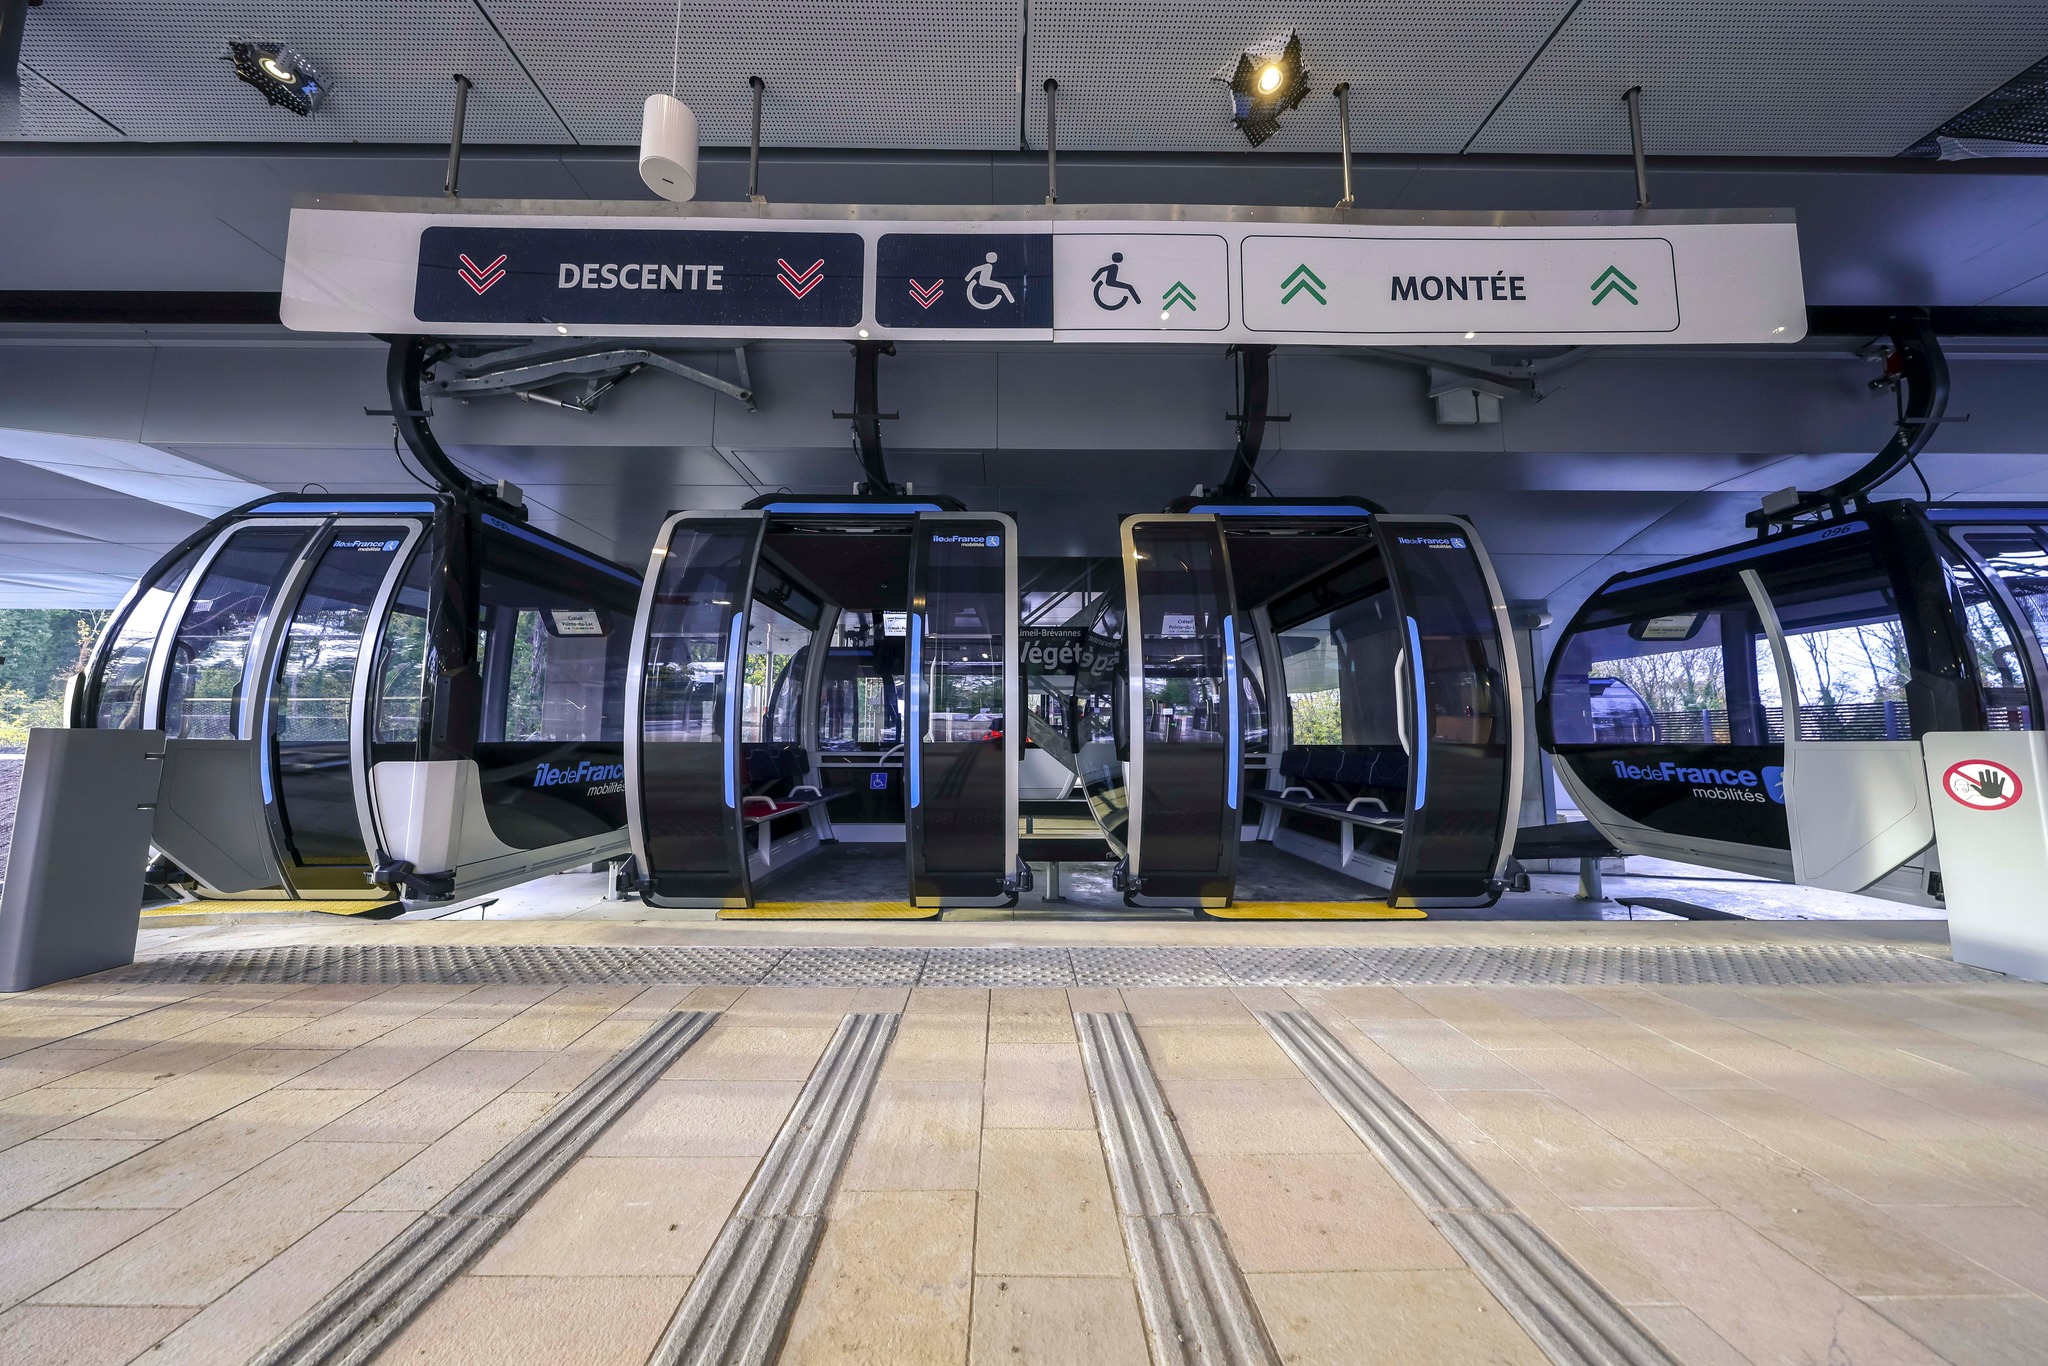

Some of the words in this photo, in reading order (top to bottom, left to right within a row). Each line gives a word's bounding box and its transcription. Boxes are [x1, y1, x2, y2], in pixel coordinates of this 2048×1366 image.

[558, 263, 724, 291] DESCENTE
[1391, 270, 1527, 301] MONTÉE
[1821, 524, 1853, 538] 096
[1692, 787, 1766, 803] mobilités
